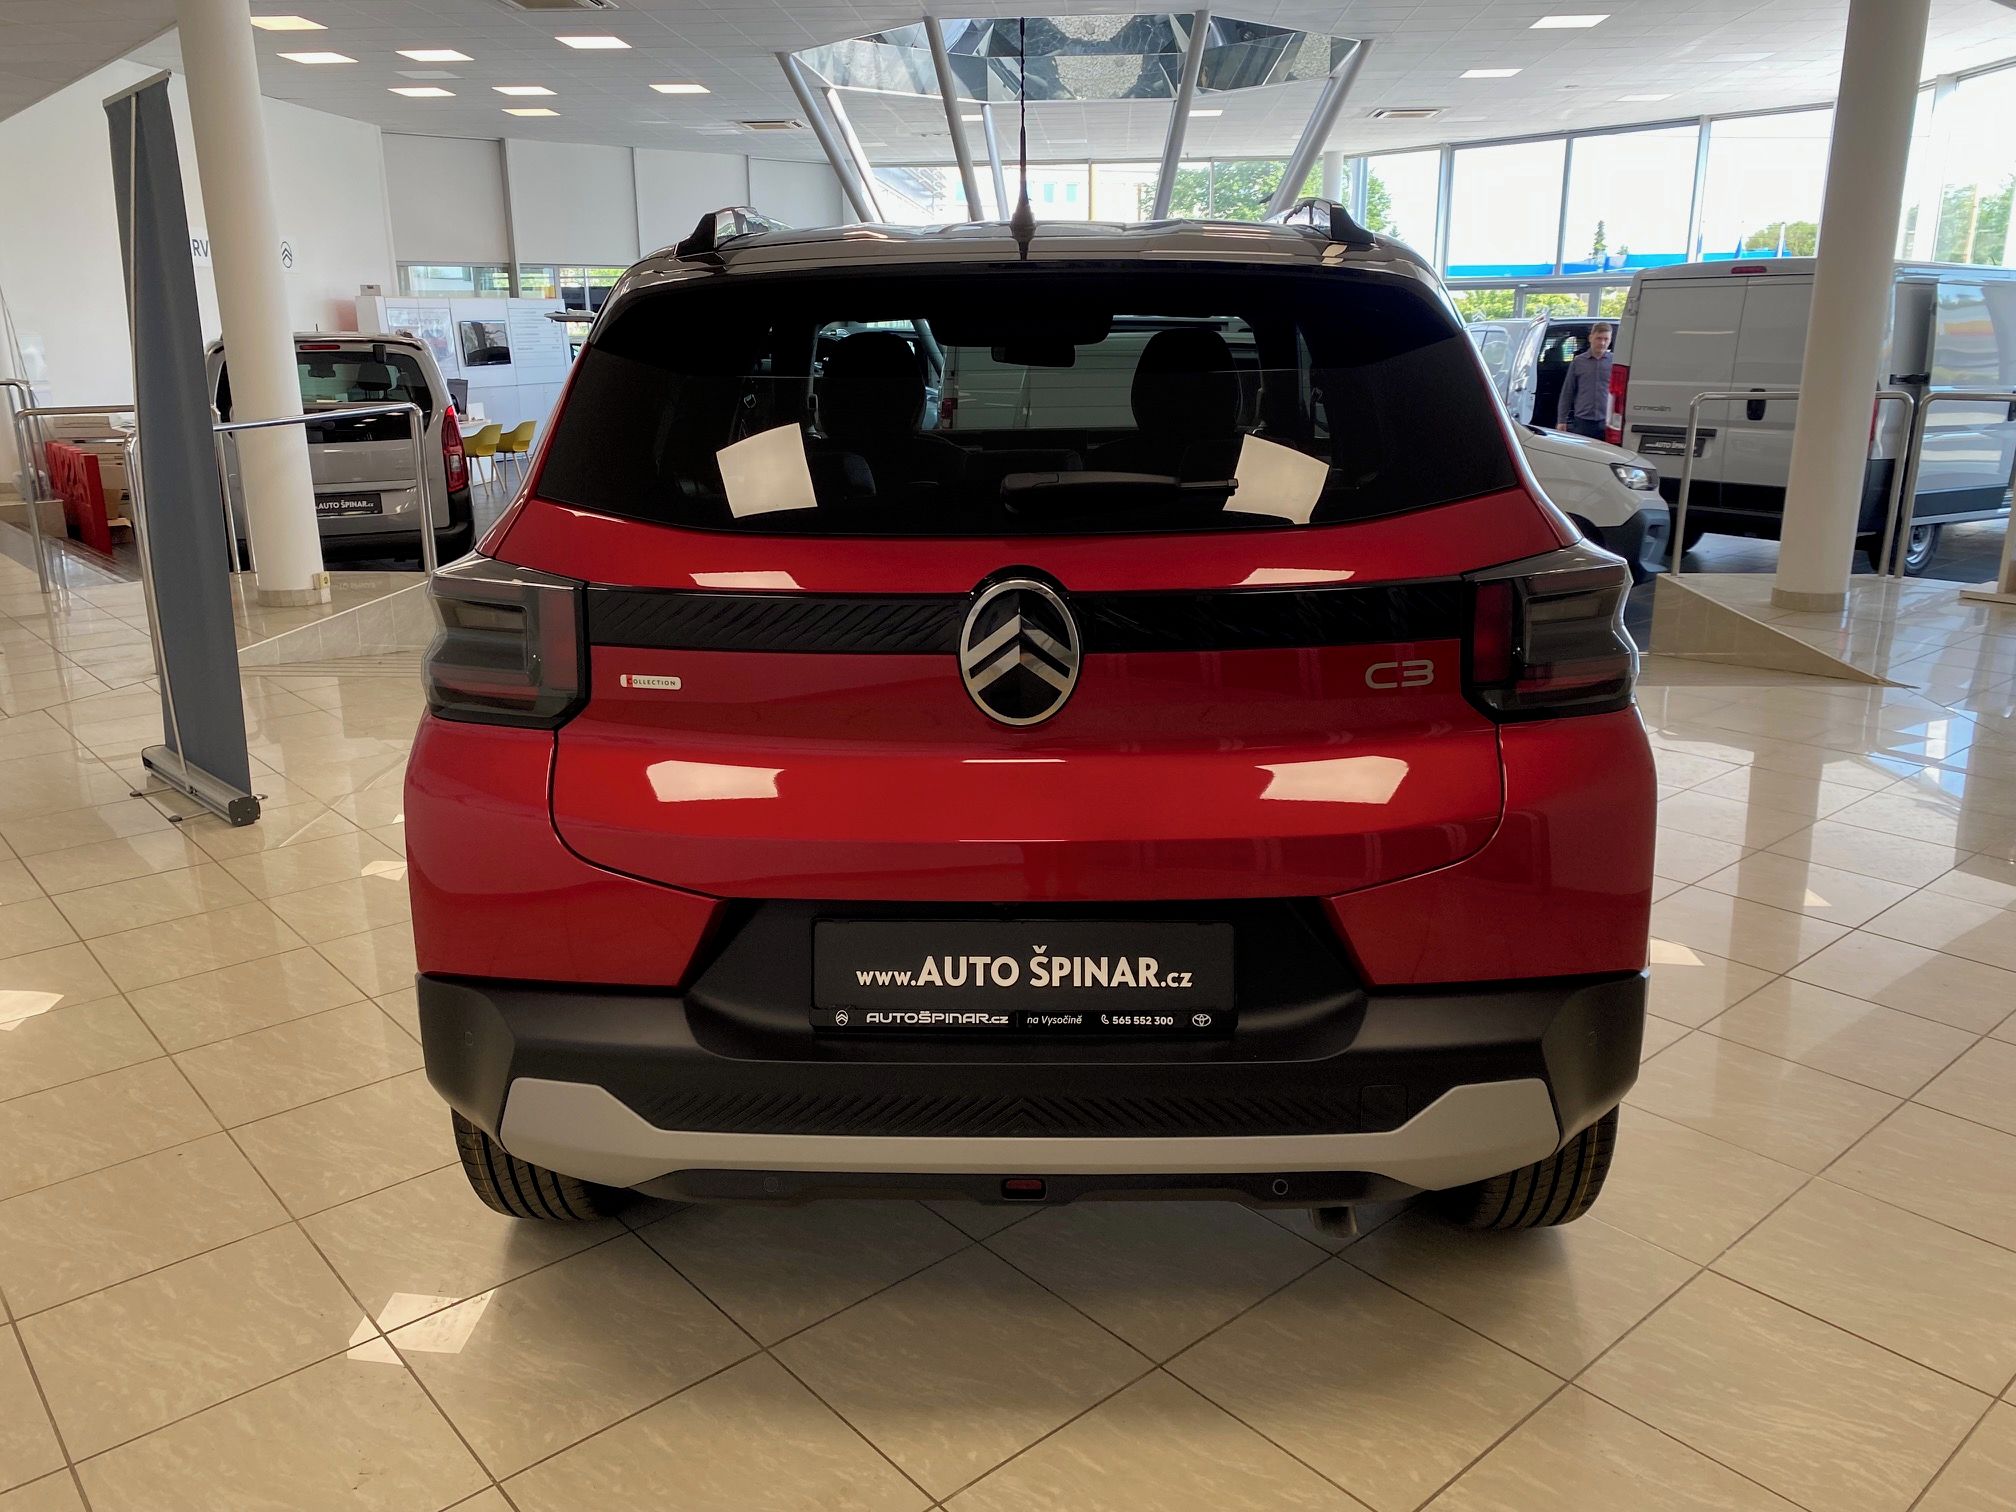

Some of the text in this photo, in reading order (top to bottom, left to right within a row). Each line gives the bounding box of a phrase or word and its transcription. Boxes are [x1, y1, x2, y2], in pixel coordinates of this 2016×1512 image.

[1365, 659, 1434, 689] C3
[627, 678, 676, 687] COLLECTION
[856, 945, 1193, 988] www.AUTO ŠPINAR.cz
[866, 1010, 1009, 1024] AUTOŠPINAR.cz
[1041, 1014, 1083, 1026] Vysočině
[1112, 1016, 1174, 1025] 565 552 300
